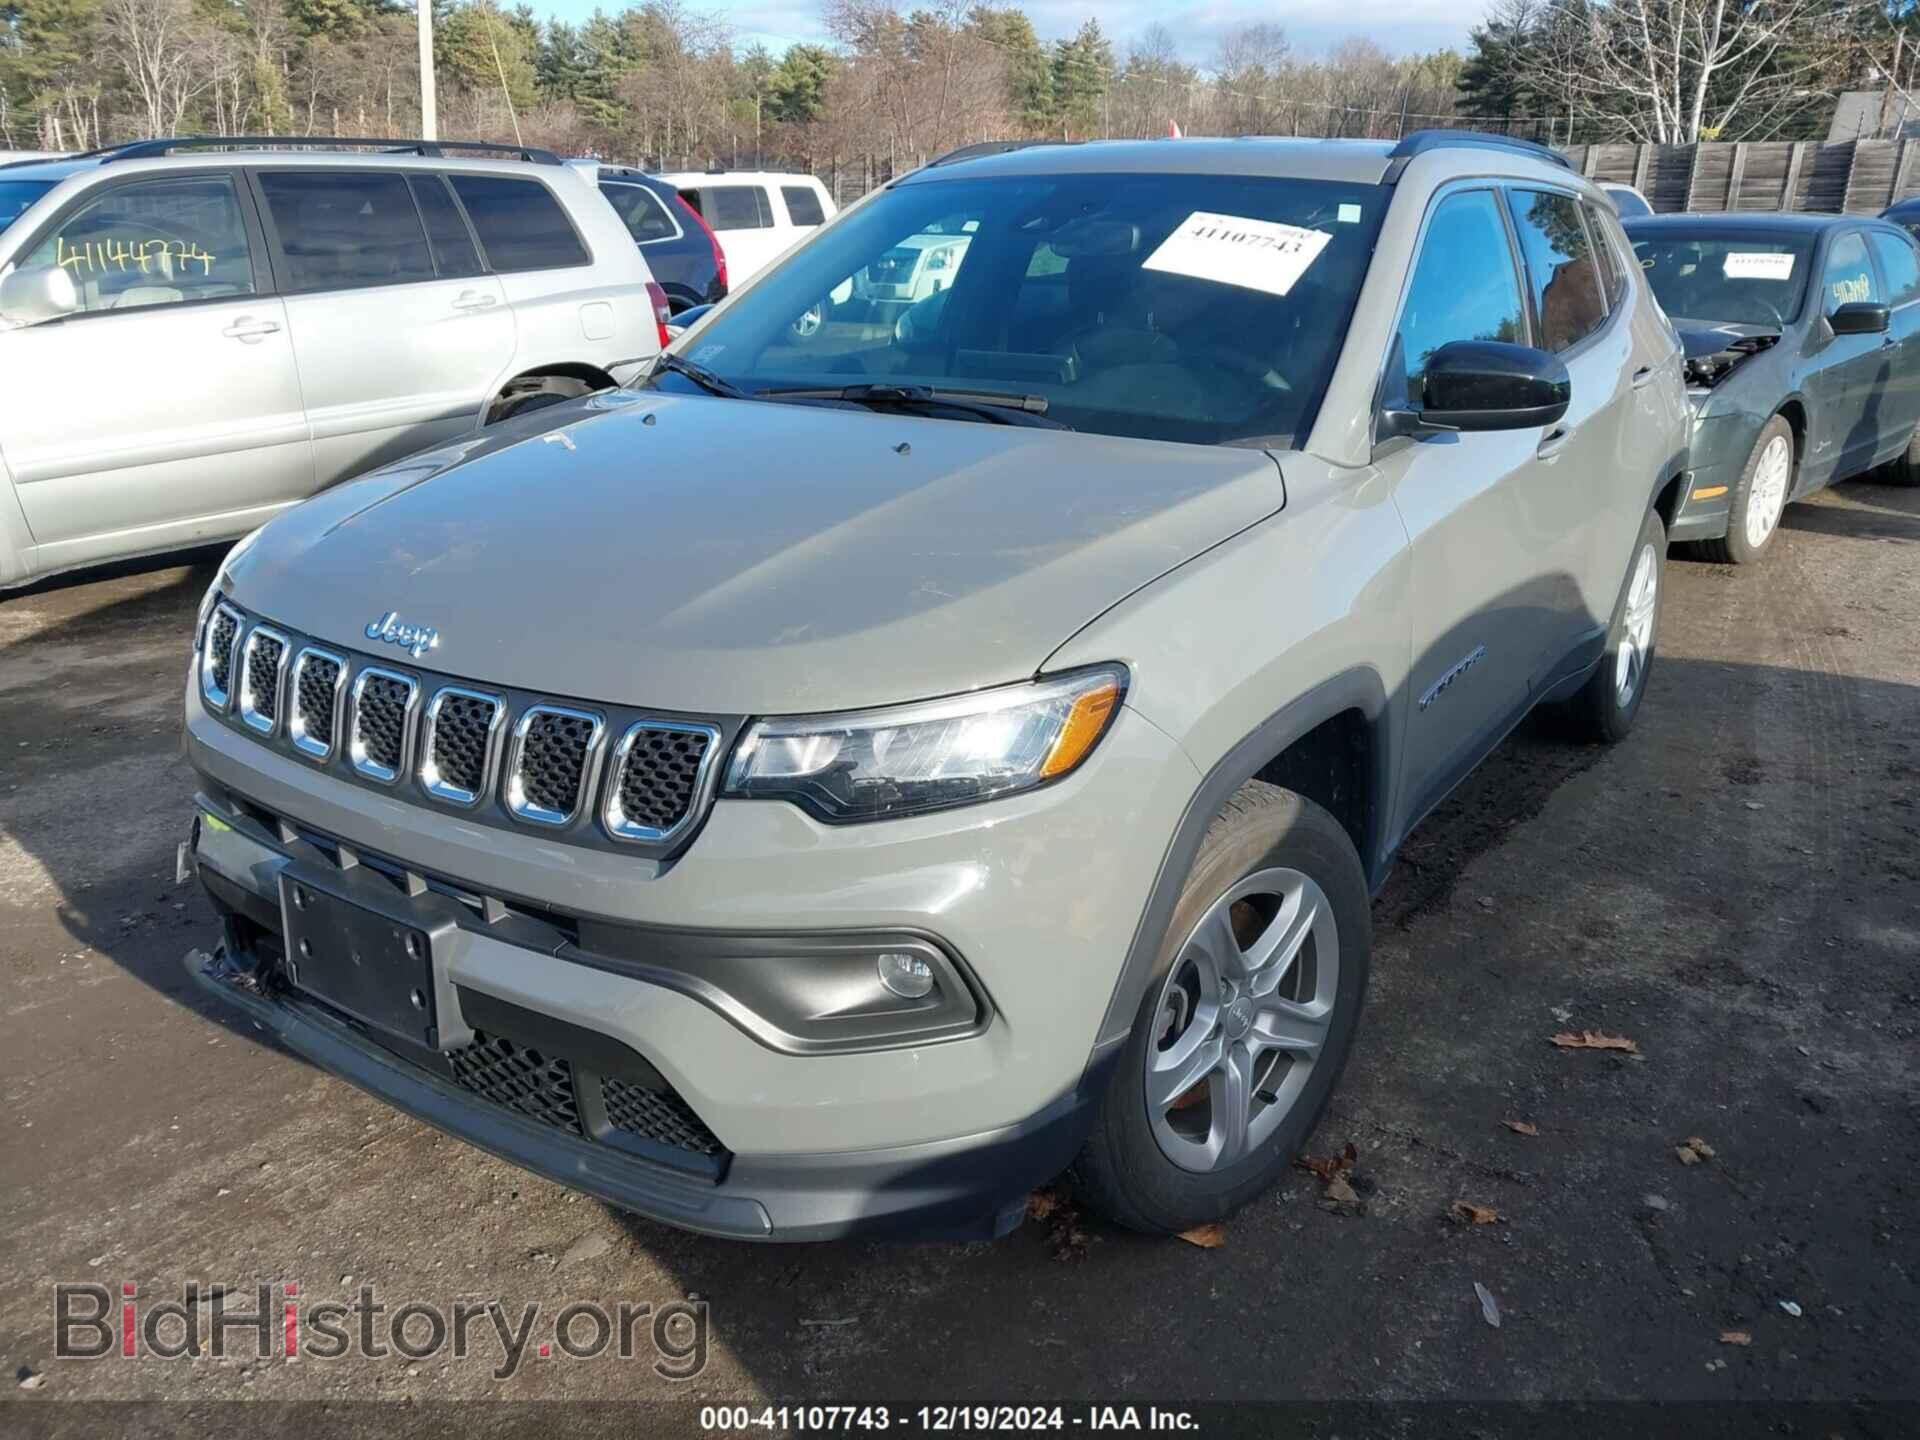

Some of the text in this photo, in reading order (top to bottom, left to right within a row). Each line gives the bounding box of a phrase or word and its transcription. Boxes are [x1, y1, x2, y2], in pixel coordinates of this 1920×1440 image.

[56, 237, 216, 279] 41144774
[1192, 226, 1303, 253] 41107743
[364, 611, 440, 658] Jeep
